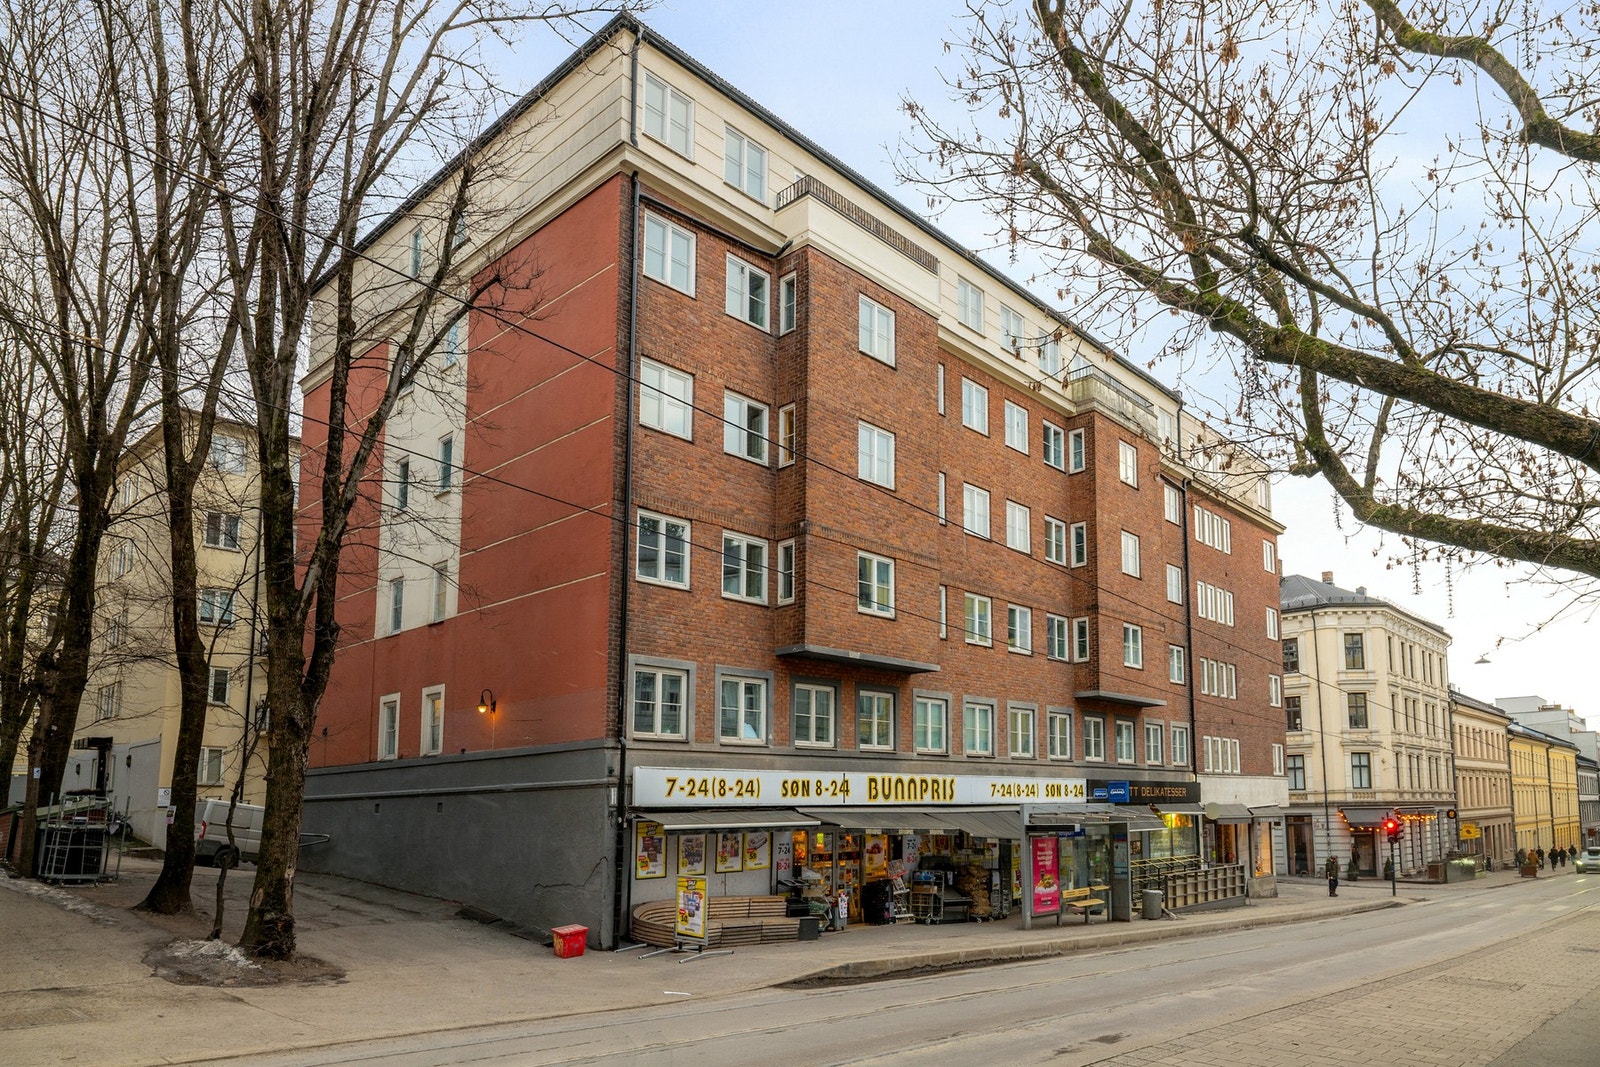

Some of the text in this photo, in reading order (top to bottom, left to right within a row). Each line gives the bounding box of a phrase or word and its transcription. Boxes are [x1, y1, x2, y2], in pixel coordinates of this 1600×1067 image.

[665, 776, 761, 799] 7-24(8-24)
[781, 779, 850, 798] SØN 8-24
[867, 775, 955, 802] BUNNPRIS
[990, 783, 1039, 799] 7-24(8-24)
[1045, 784, 1084, 798] SØN 8-24
[1129, 786, 1187, 797] TT DELIKATESSER
[778, 847, 790, 855] 7-24
